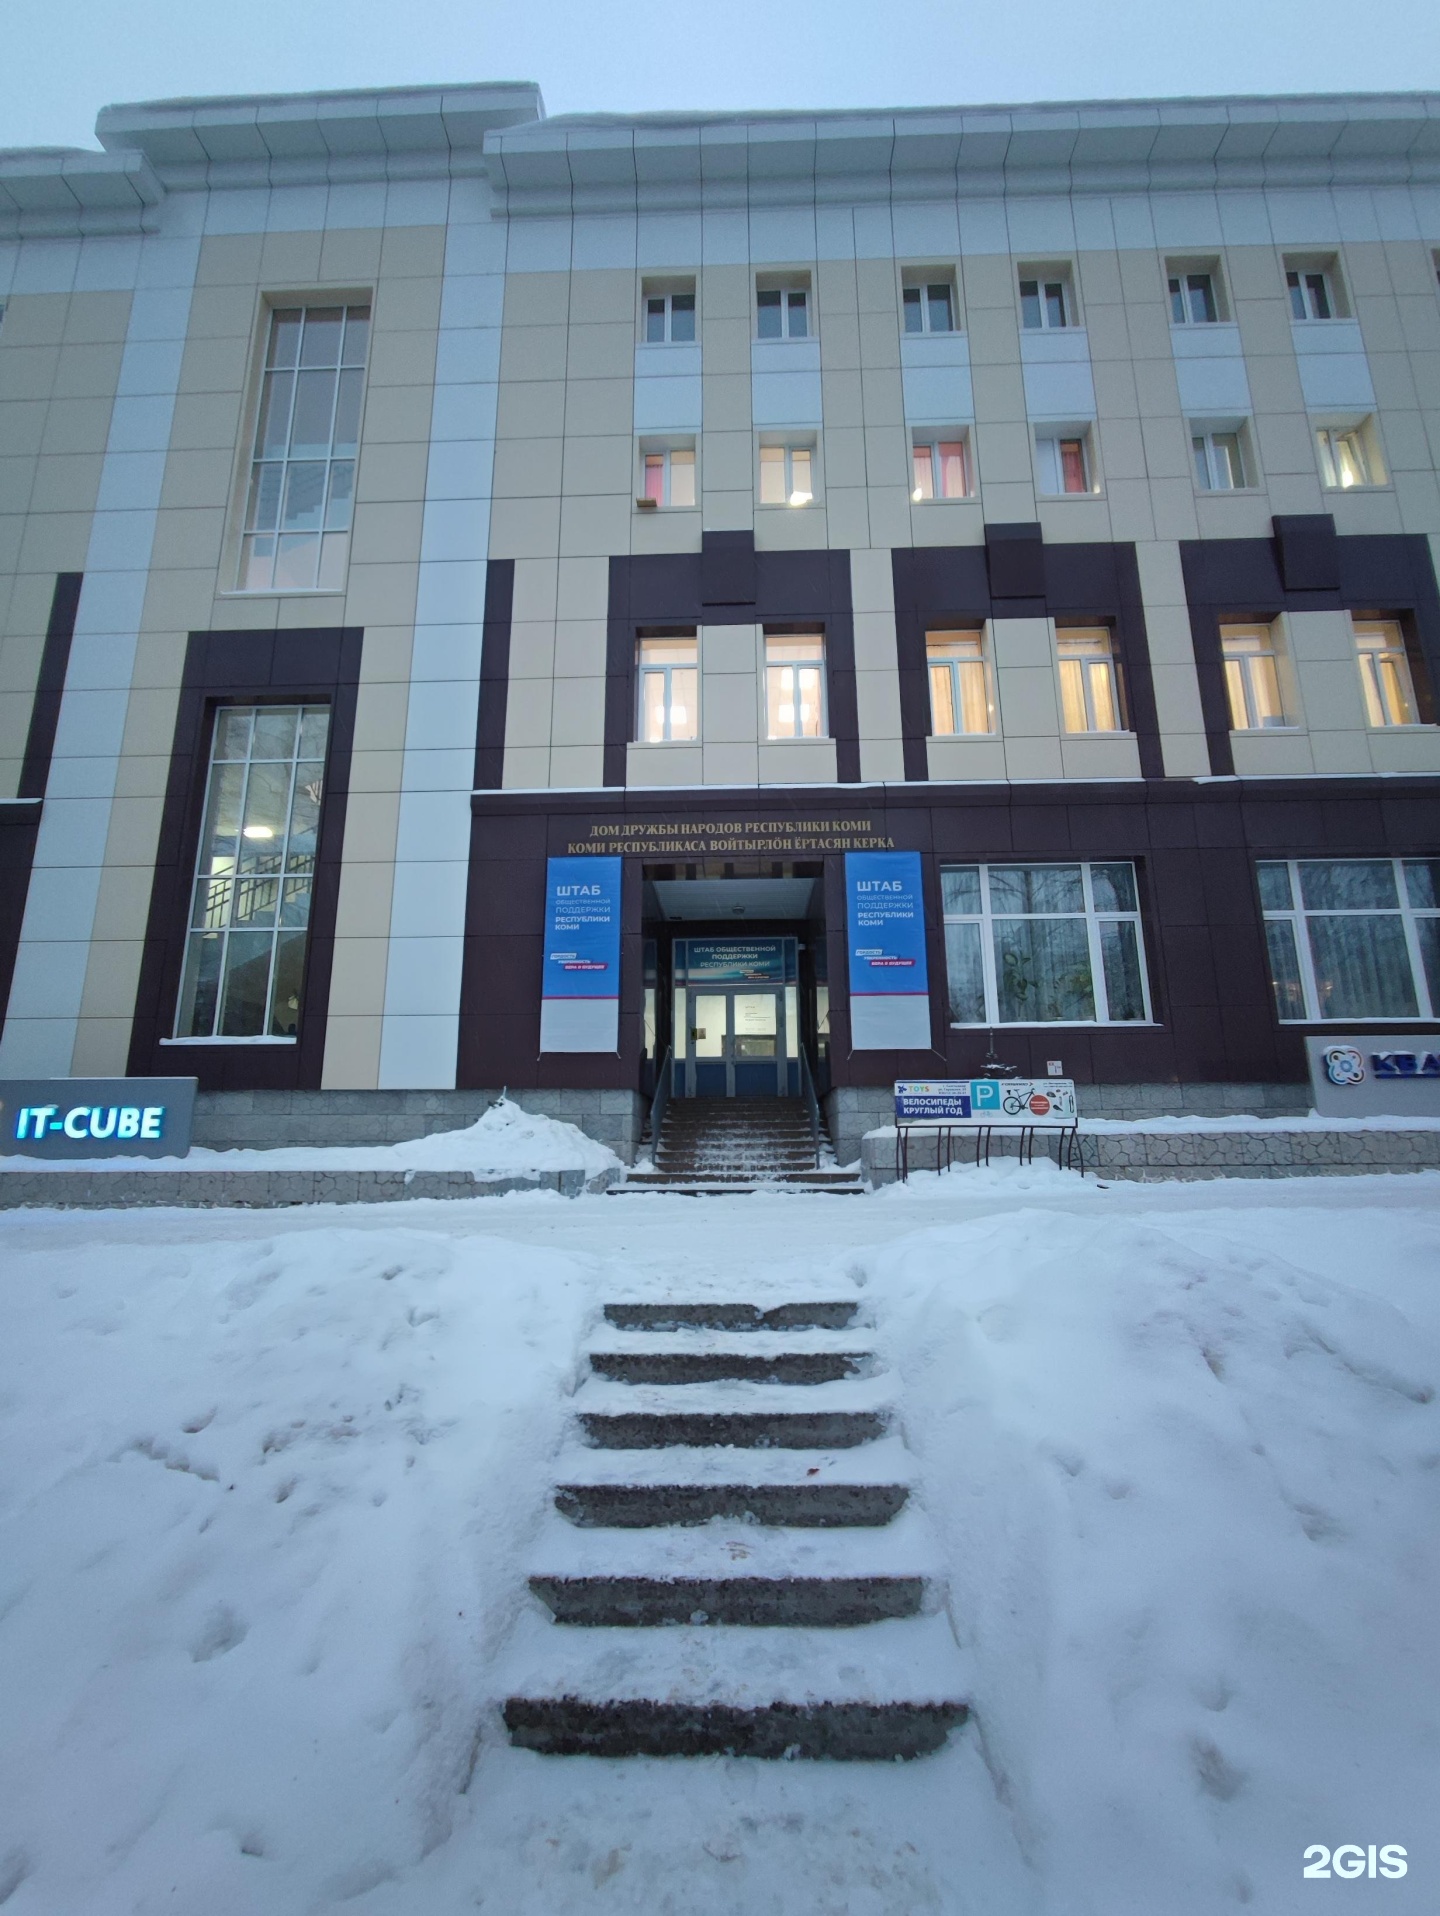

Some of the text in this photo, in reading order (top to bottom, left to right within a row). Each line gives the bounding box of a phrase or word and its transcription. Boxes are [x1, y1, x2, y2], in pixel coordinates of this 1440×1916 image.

[590, 821, 871, 837] ДОМ ДРУЖБЫ НАРОДОВ РЕСПУБЛИКИ КОМИ
[568, 843, 606, 853] КОМИ
[609, 841, 706, 853] РЕСПУБЛИКАСА
[795, 837, 850, 849] ЁРТАСЯН
[853, 837, 895, 848] КЕРКА
[556, 885, 601, 896] ШТАБ
[857, 881, 902, 891] ШТАБ
[555, 906, 611, 914] ПОДДЕРЖКИ
[1369, 1053, 1440, 1073] КВА
[903, 1098, 961, 1106] ВЕЛОСИПЕДЫ
[903, 1106, 963, 1115] КРУГЛЫЙ ГОД
[16, 1106, 164, 1139] IT-CUBE
